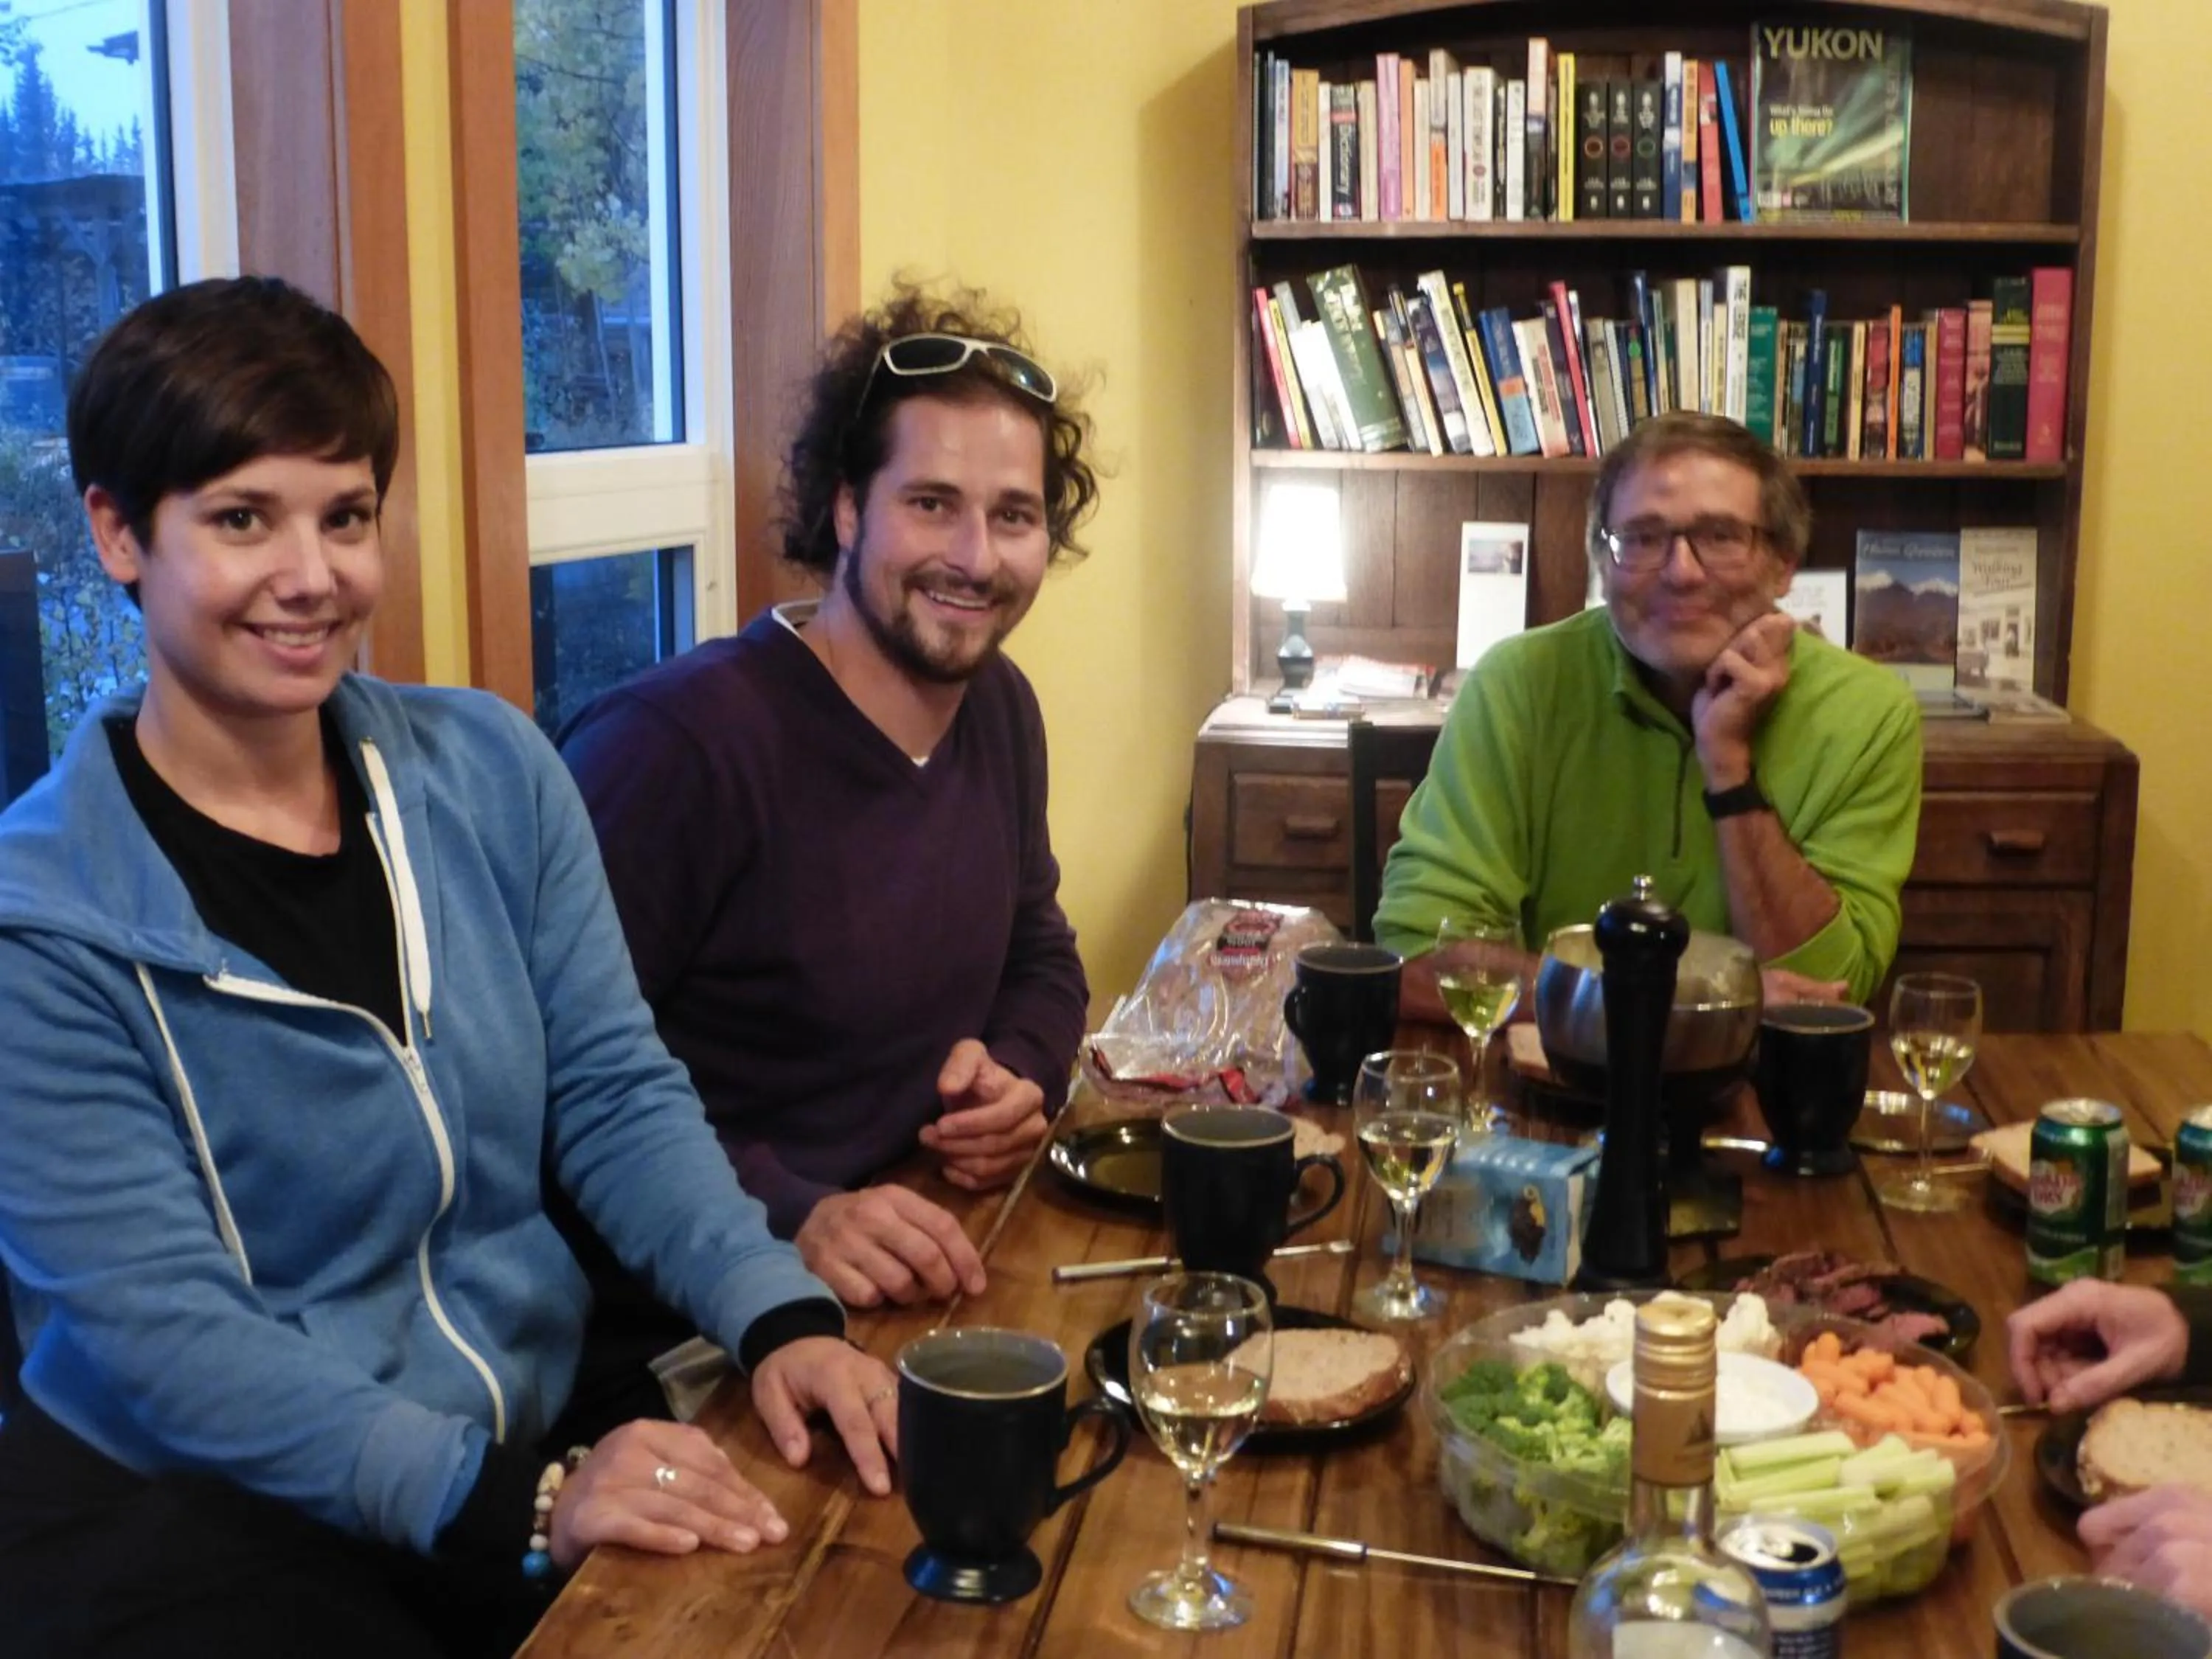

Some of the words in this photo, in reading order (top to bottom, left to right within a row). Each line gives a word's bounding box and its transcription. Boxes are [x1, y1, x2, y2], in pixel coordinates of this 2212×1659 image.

[1763, 27, 1883, 60] YUKON
[1770, 118, 1788, 138] up
[1791, 116, 1833, 136] there?
[1335, 124, 1352, 195] Dictionary
